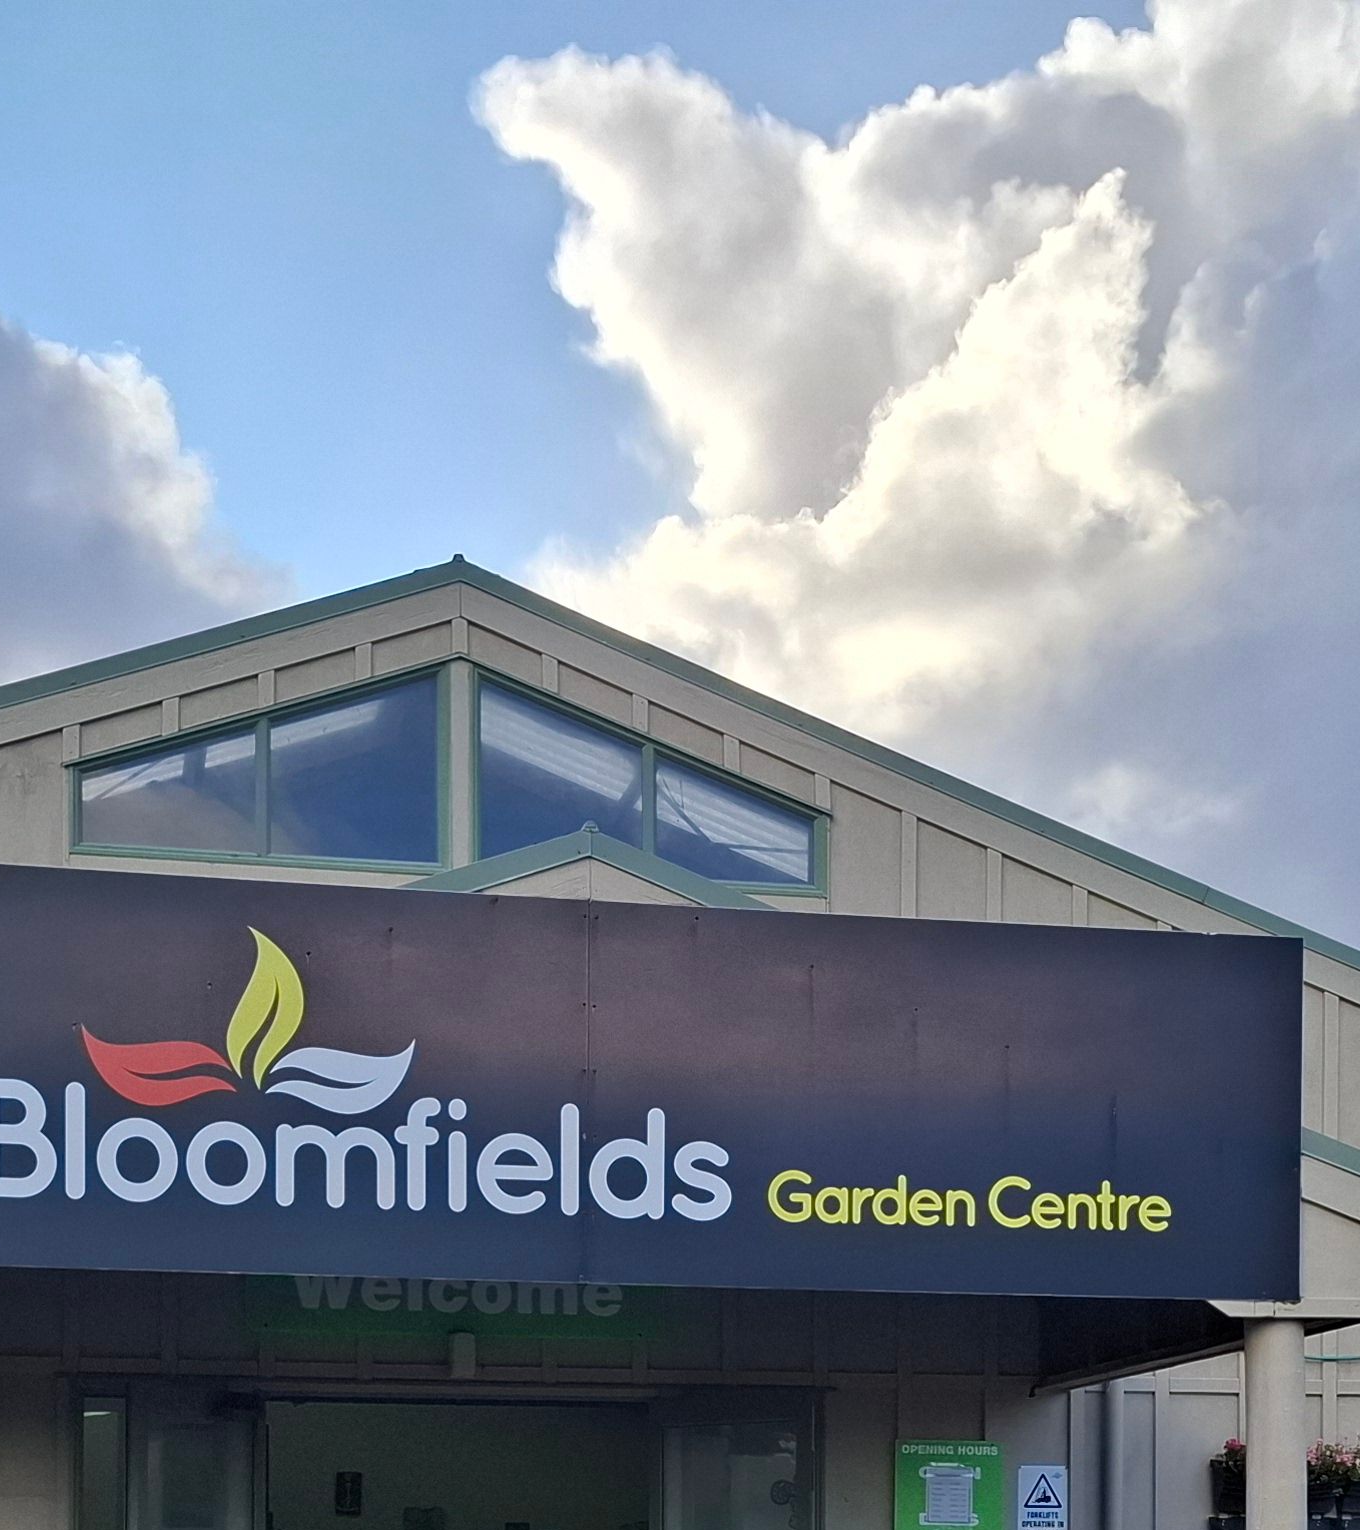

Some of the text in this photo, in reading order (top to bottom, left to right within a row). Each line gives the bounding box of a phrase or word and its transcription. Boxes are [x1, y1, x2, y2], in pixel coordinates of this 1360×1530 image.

[768, 1169, 1172, 1232] Garden Centre
[902, 1444, 998, 1456] OPENING HOURS
[1027, 1511, 1059, 1519] FORKLIFTS
[1021, 1520, 1065, 1528] OPERATING IN
